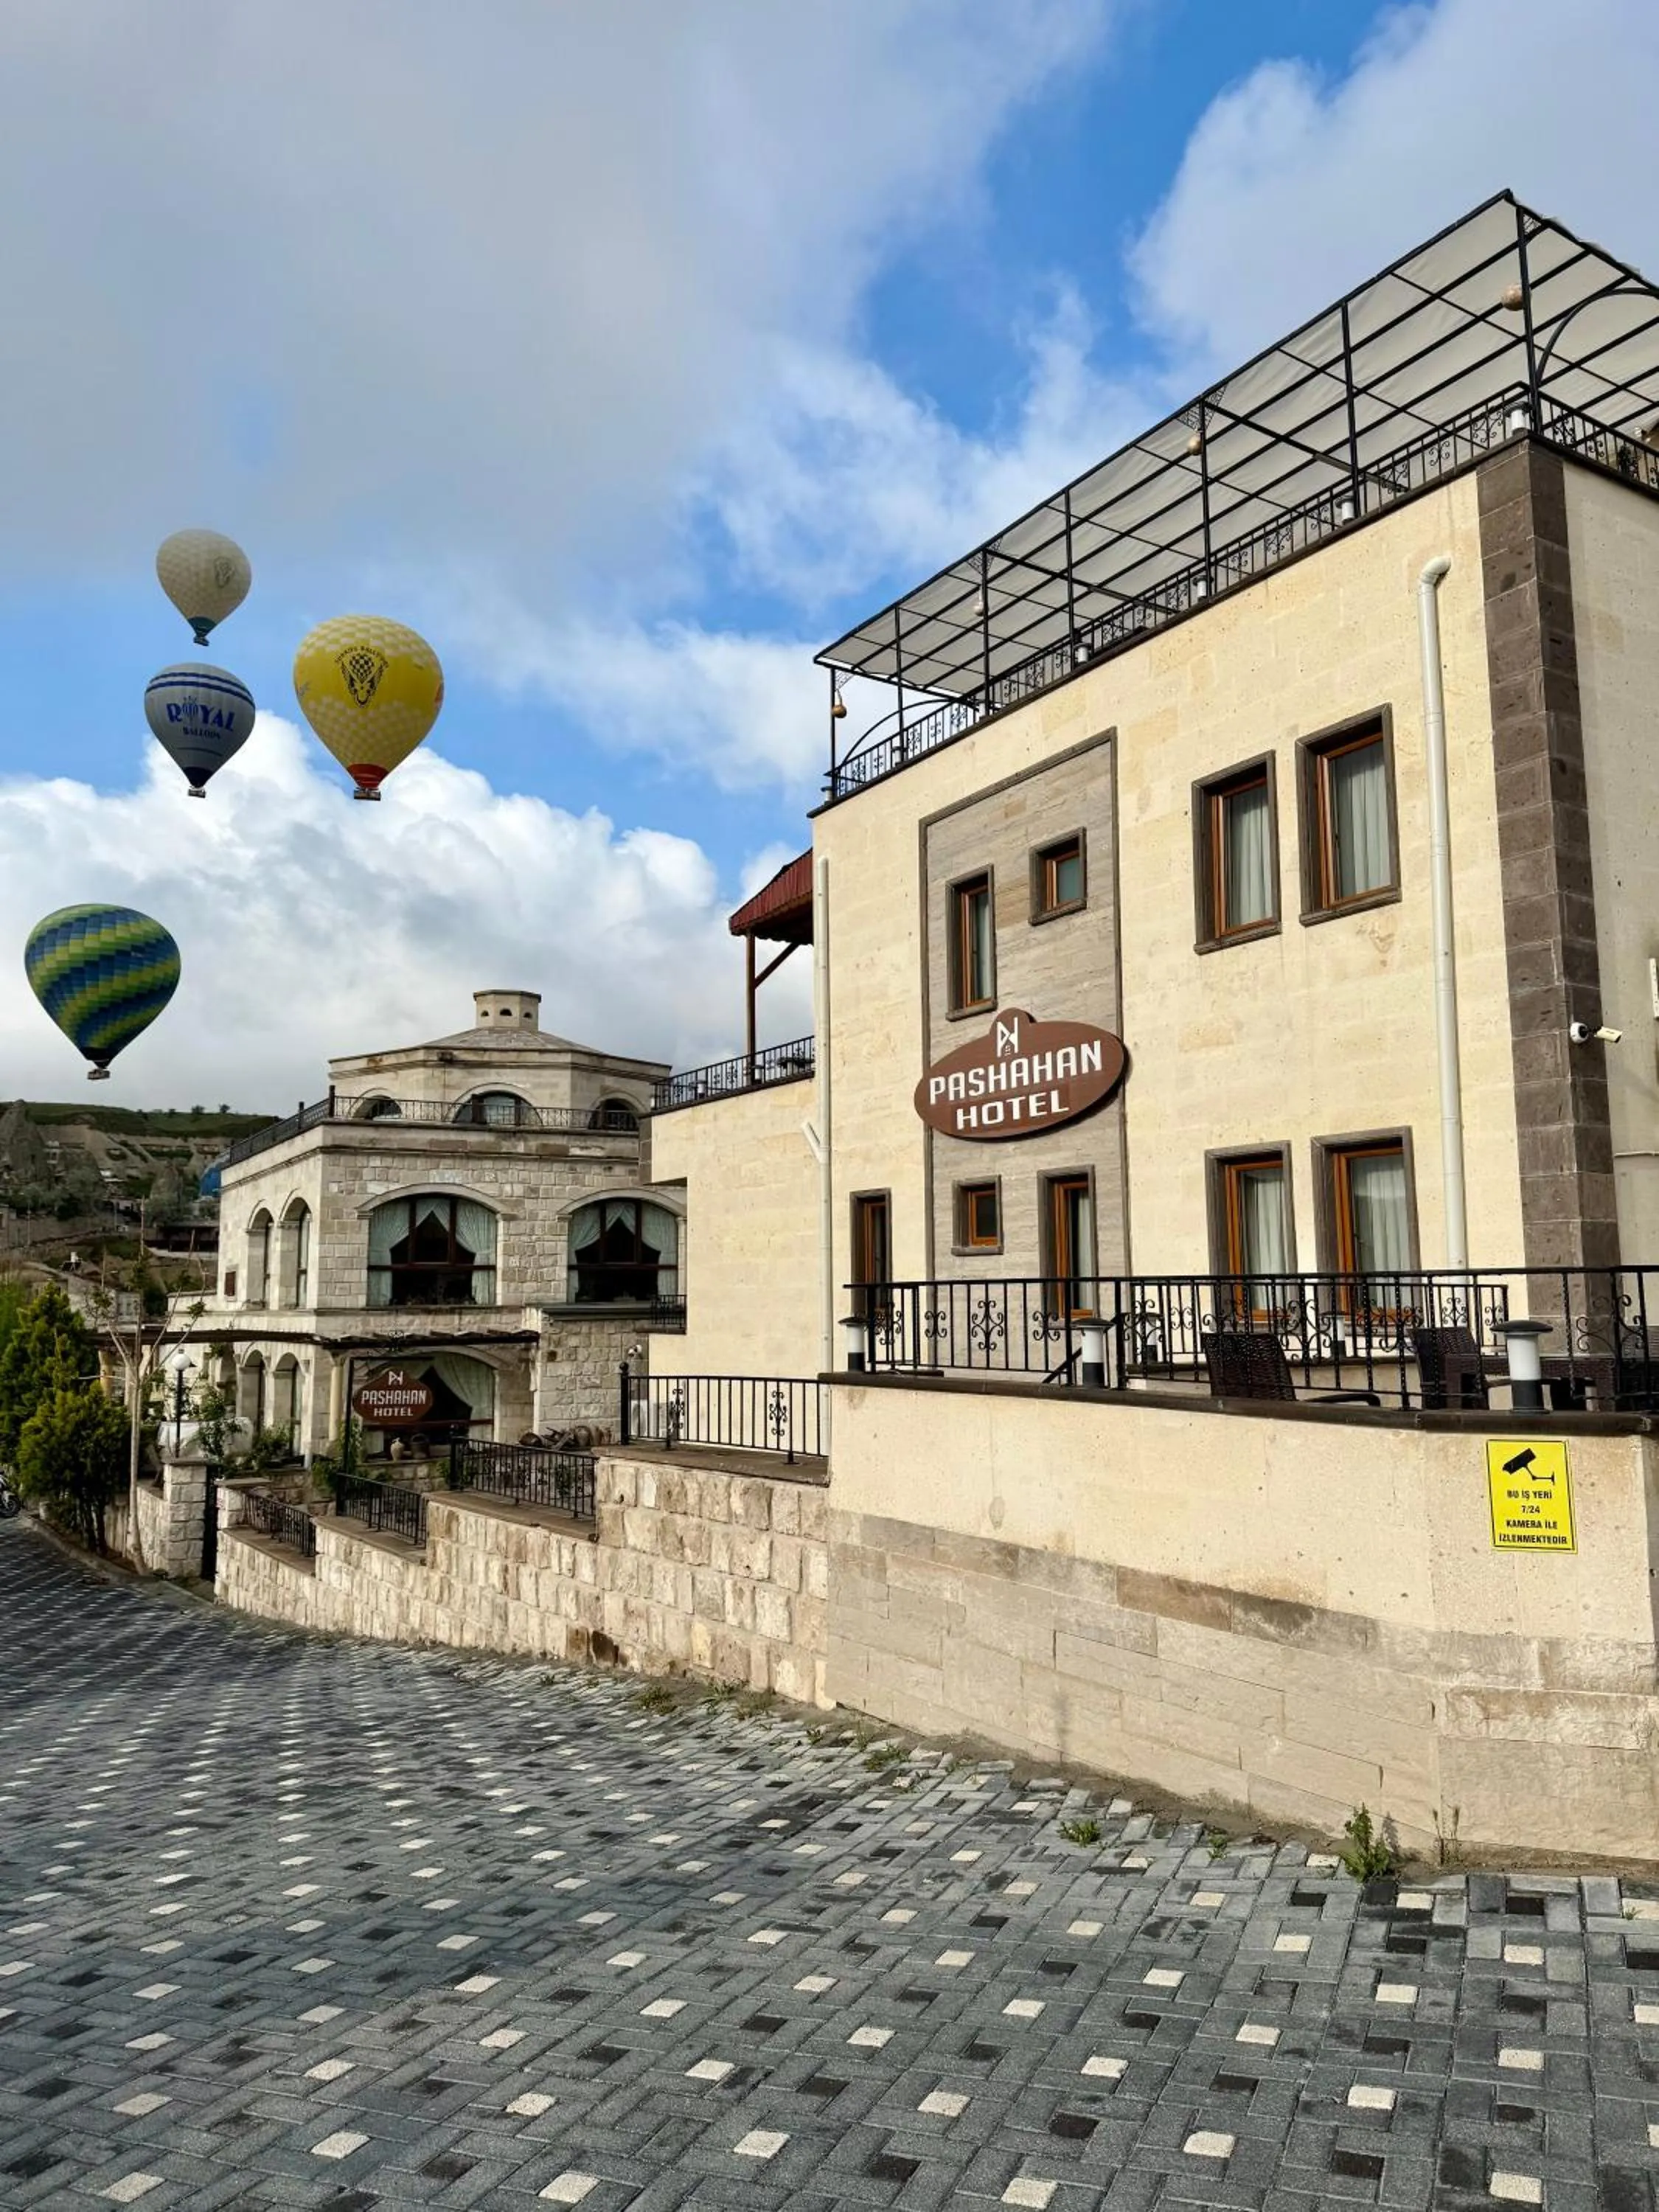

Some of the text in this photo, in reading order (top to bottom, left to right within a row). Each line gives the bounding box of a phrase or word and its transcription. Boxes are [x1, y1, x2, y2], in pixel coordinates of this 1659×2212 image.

[166, 701, 234, 732] ROYAL
[929, 1040, 1102, 1105] PASHAHAN
[956, 1089, 1069, 1130] HOTEL
[361, 1390, 427, 1405] PASHAHAN
[374, 1408, 414, 1416] HOTEL
[1521, 1505, 1540, 1514] 7/24
[1506, 1520, 1543, 1528] KAMERA
